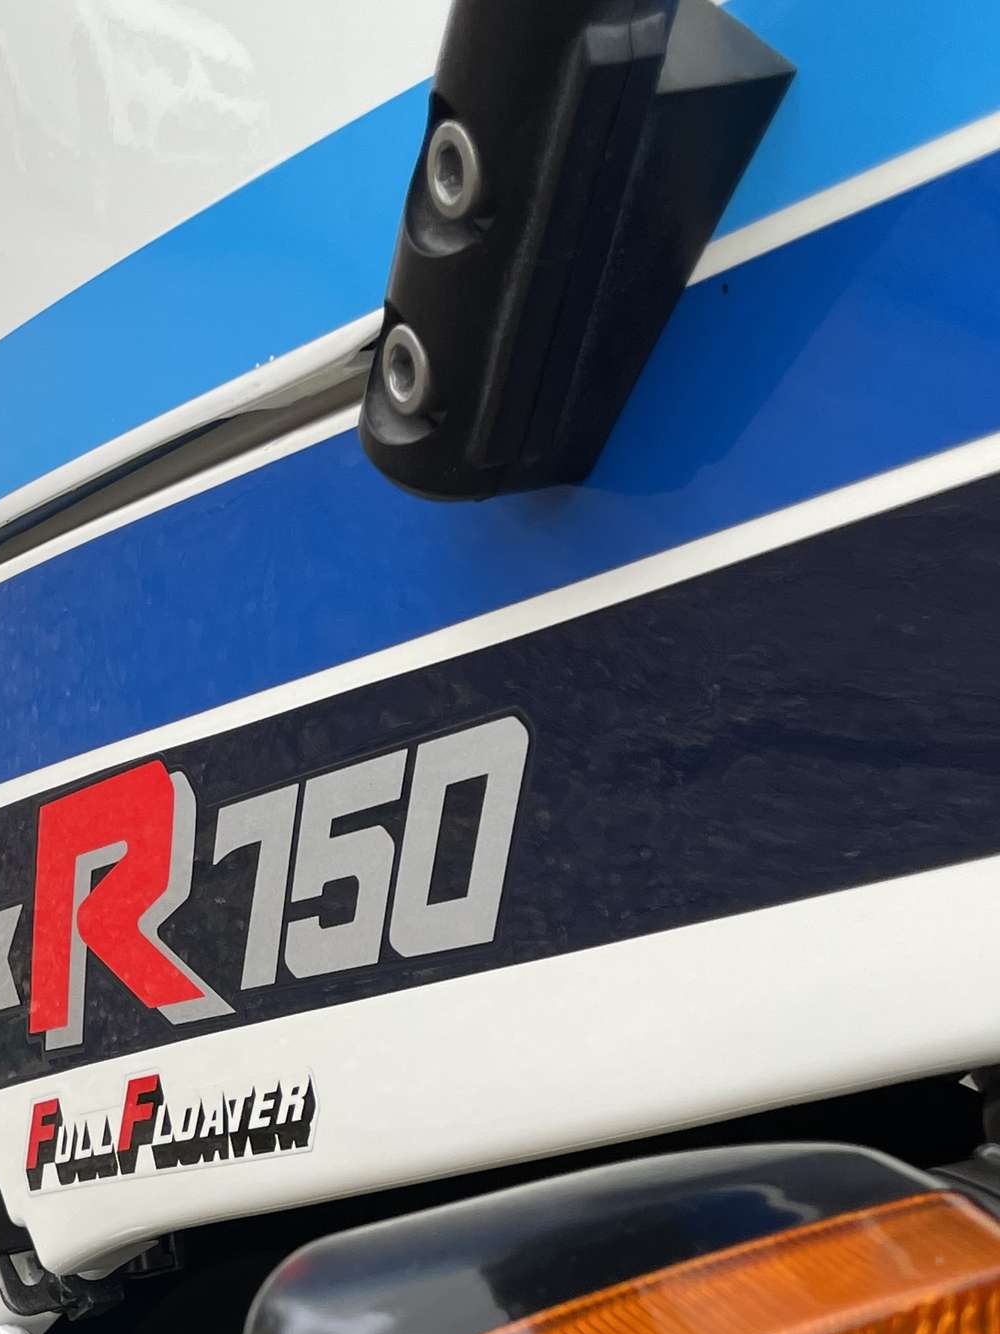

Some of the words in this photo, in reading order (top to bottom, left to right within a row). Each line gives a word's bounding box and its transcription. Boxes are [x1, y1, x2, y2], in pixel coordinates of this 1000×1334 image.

[28, 759, 236, 1051] R
[211, 715, 530, 991] 750
[117, 1073, 317, 1175] FLOATER
